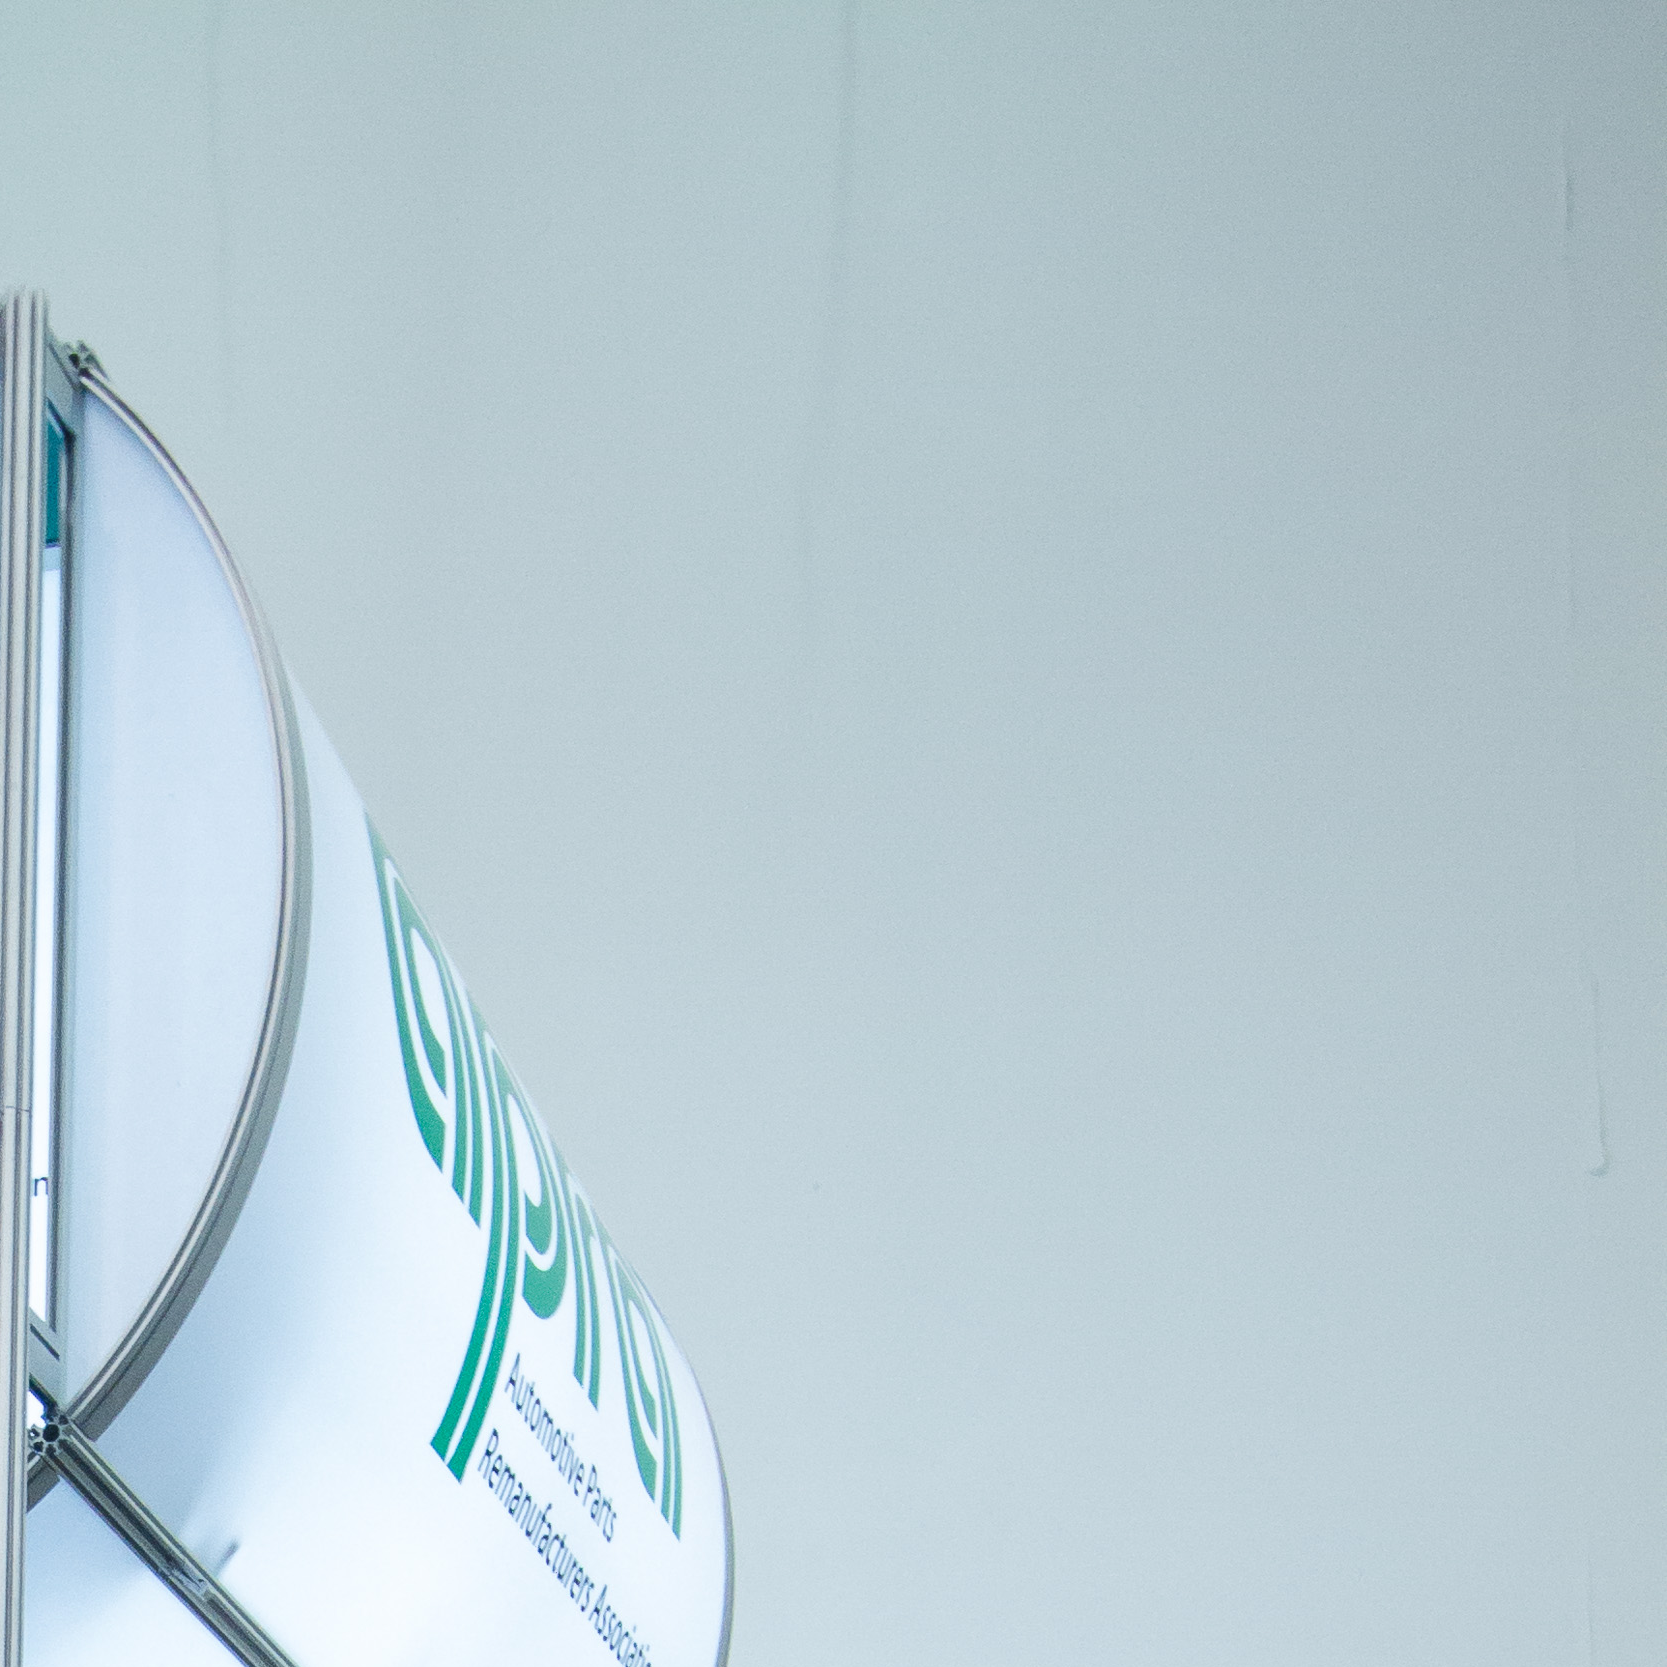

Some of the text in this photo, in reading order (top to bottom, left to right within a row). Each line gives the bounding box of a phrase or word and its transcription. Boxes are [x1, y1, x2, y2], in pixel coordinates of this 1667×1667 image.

[365, 808, 682, 1541] apra
[477, 1427, 595, 1613] Remanufacturers
[504, 1352, 617, 1543] Automotive Parts
